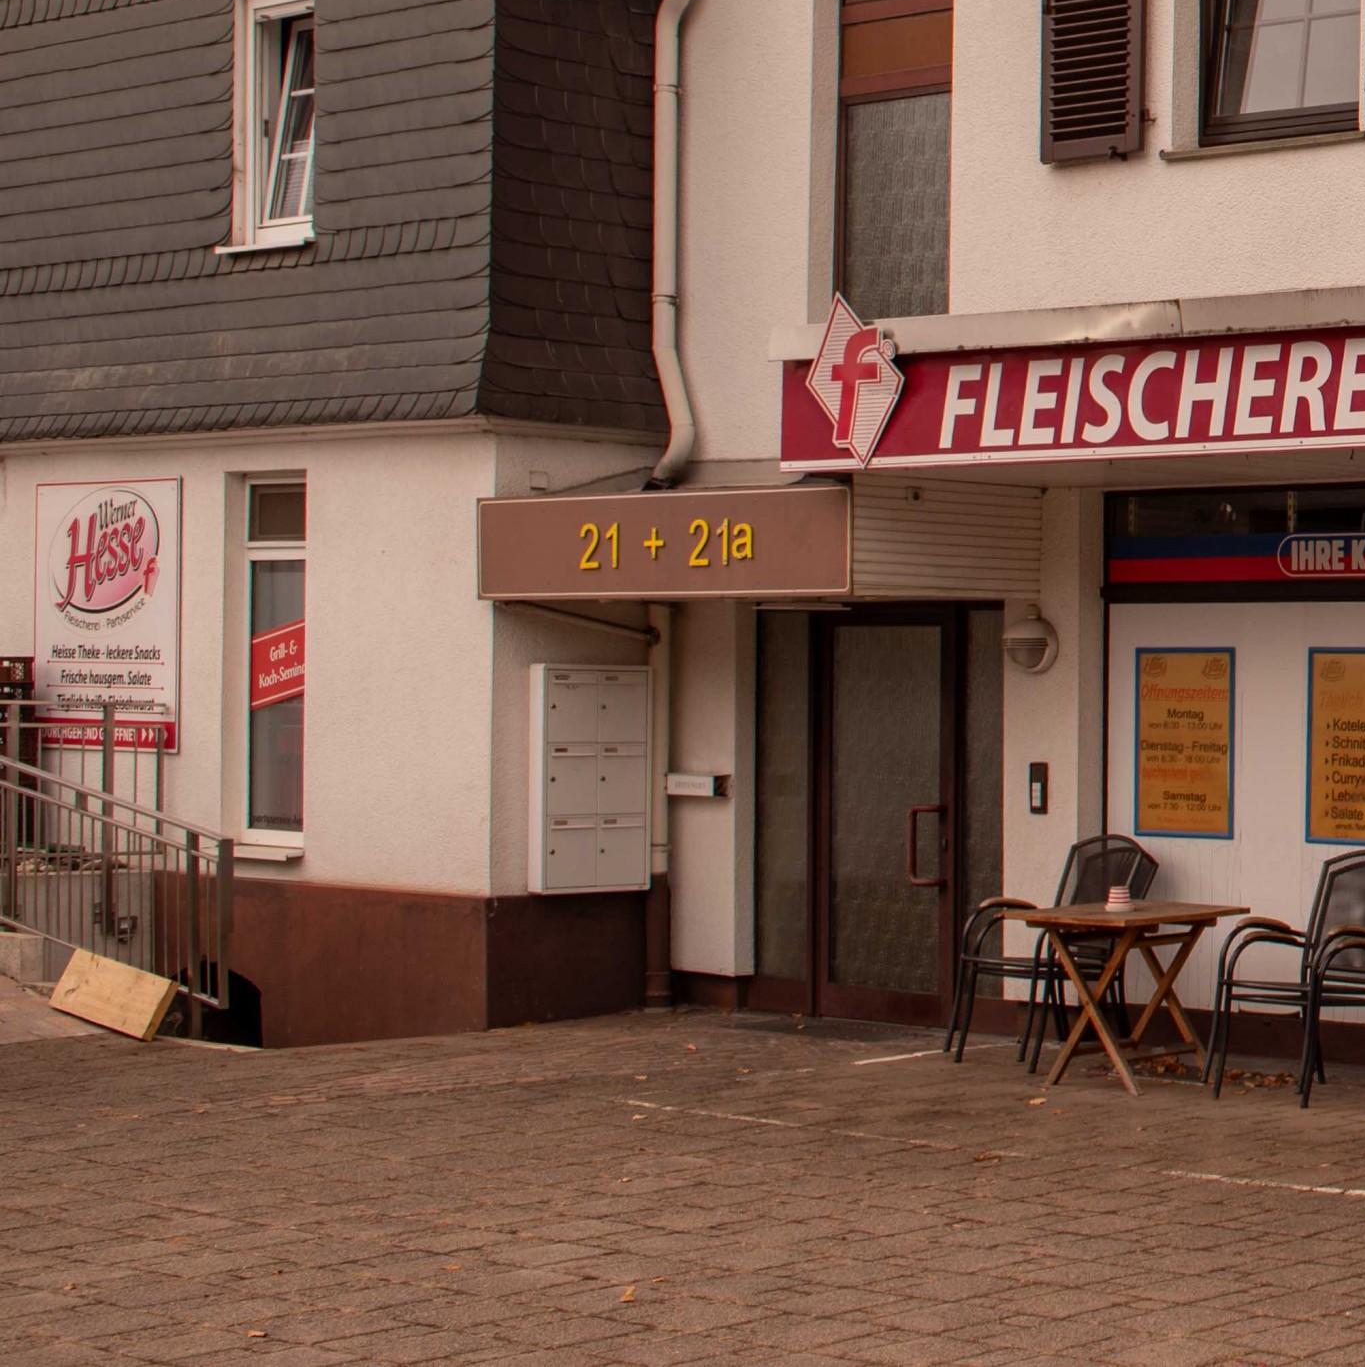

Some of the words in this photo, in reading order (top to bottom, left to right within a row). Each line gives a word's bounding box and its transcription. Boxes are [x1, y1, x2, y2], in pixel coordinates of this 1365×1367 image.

[98, 498, 137, 531] Werner
[579, 521, 620, 570] 21
[643, 527, 666, 560] +
[688, 517, 755, 567] 21a
[55, 512, 145, 612] Hesse
[1291, 539, 1345, 571] IHRE
[64, 610, 101, 631] Fleischerei
[106, 597, 145, 630] Partyservice
[51, 644, 76, 659] Heisse
[78, 644, 100, 659] Theke
[106, 644, 133, 660] leckere
[134, 645, 161, 660] Snacks
[270, 642, 288, 662] Grill-
[290, 640, 298, 655] &
[61, 669, 88, 684] Frische
[89, 669, 126, 689] hausgem.
[128, 670, 152, 686] Salate
[1167, 708, 1204, 722] Montag
[1210, 722, 1223, 731] Uhr
[1141, 740, 1184, 754] Dienstag
[1192, 740, 1228, 756] Freitag
[1162, 790, 1206, 804] Samstag
[1330, 806, 1364, 820] Salate
